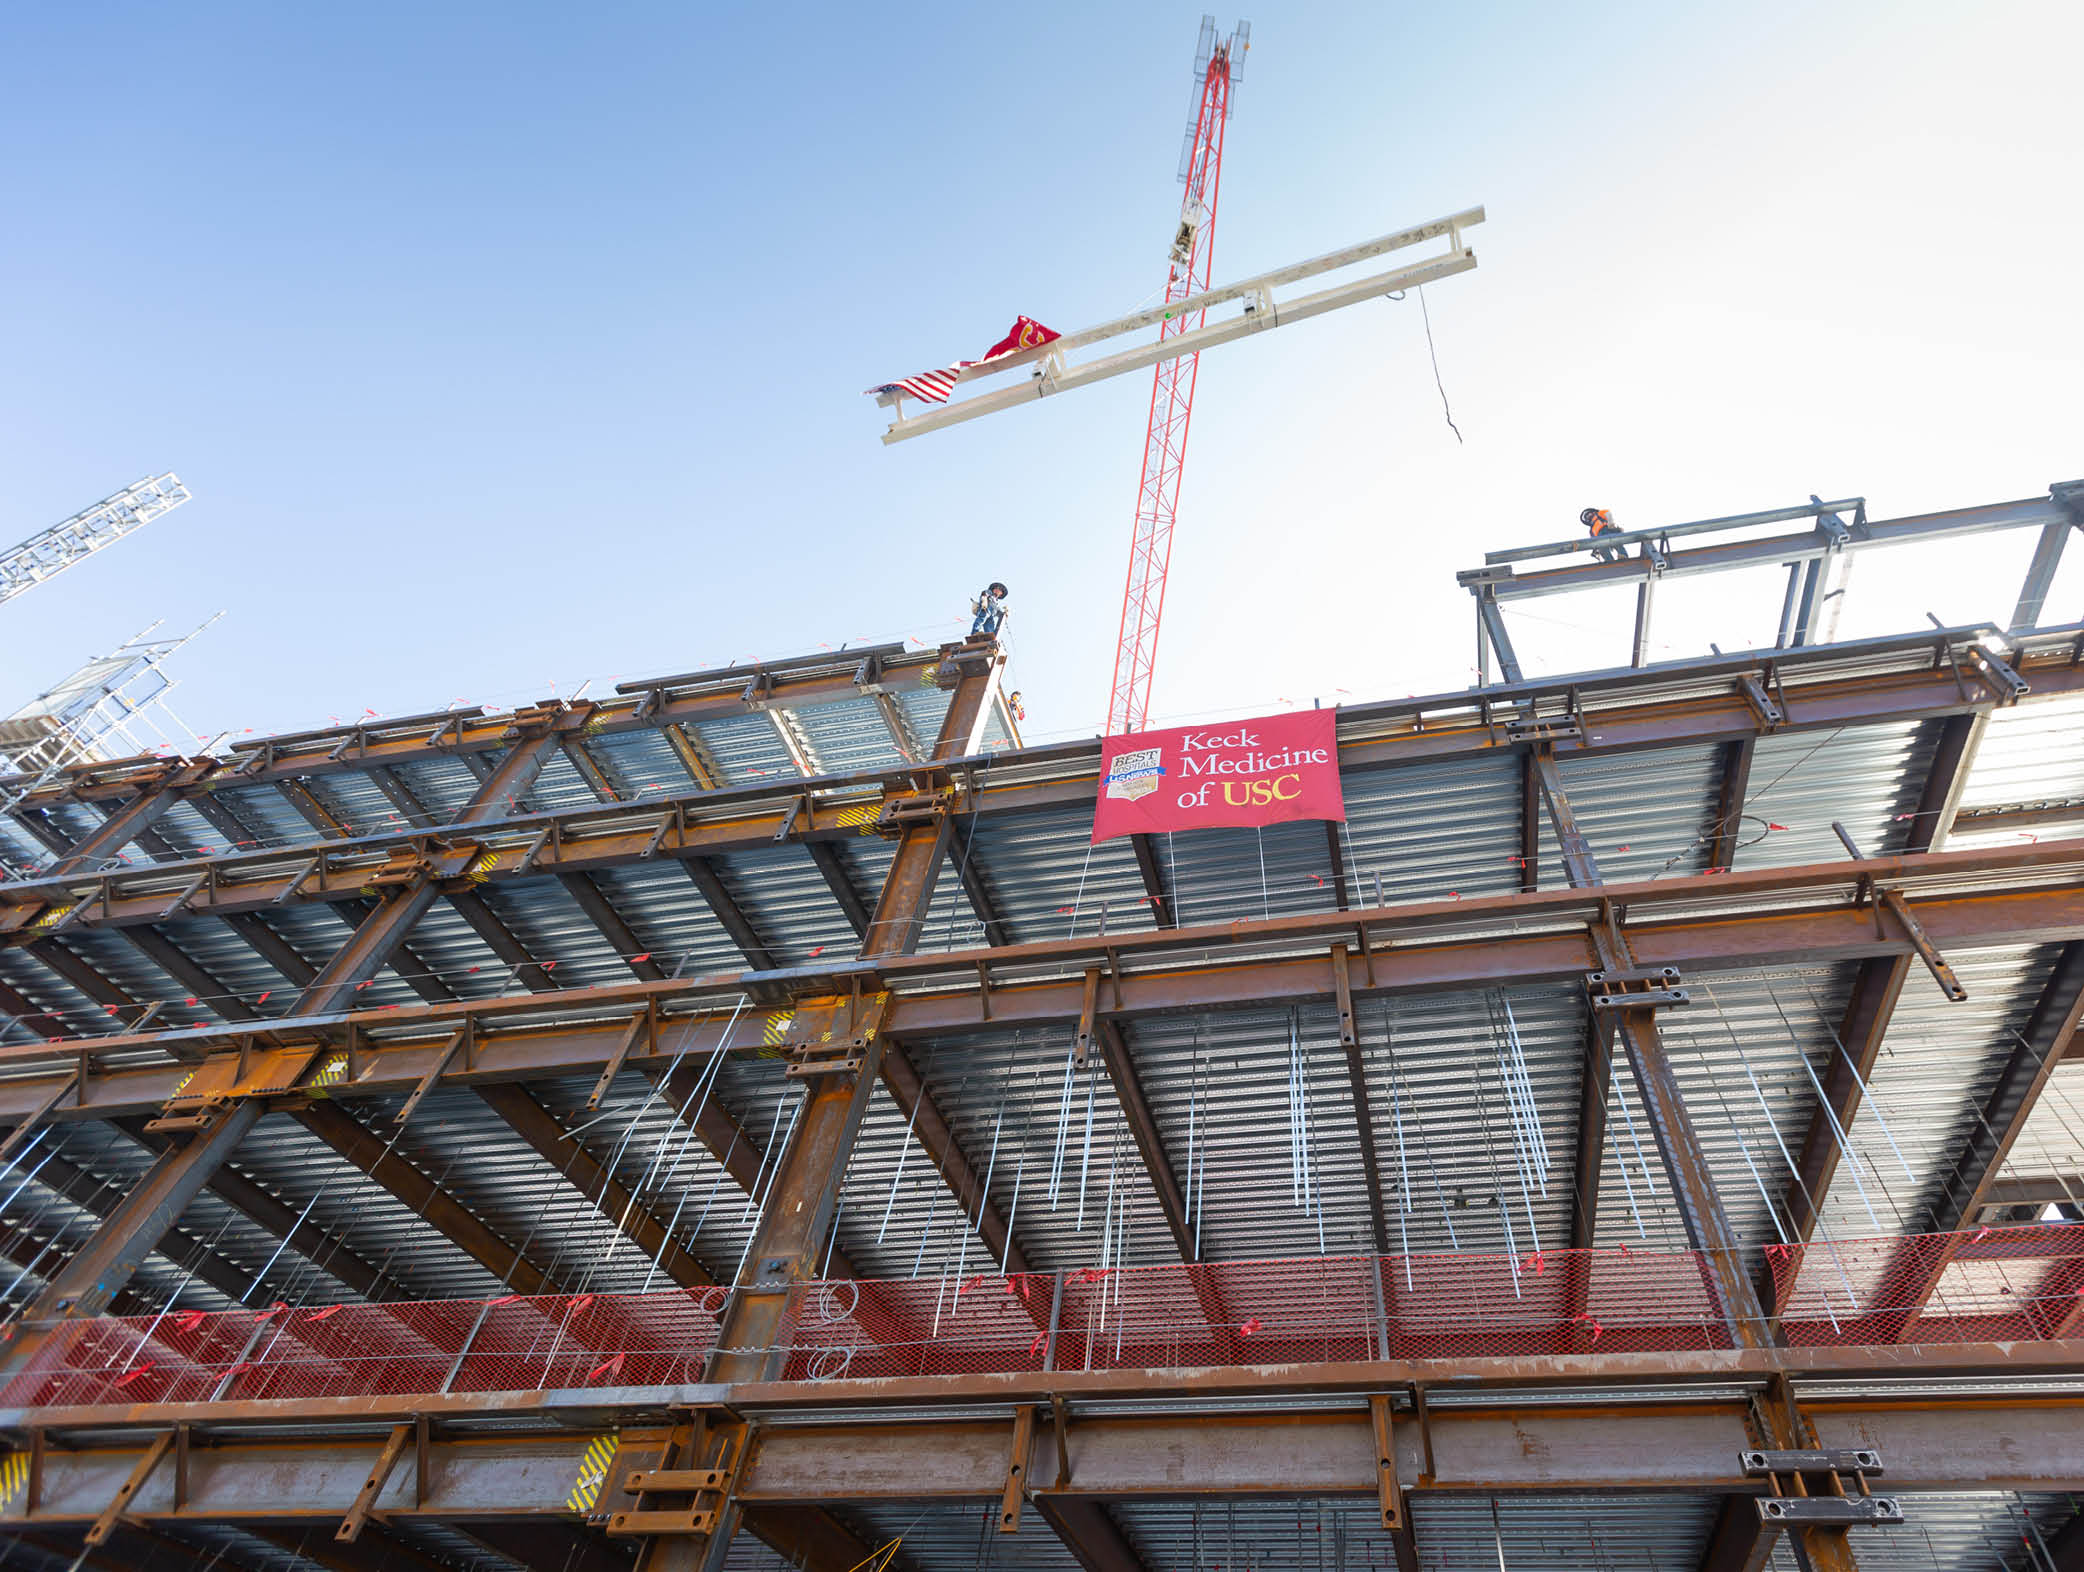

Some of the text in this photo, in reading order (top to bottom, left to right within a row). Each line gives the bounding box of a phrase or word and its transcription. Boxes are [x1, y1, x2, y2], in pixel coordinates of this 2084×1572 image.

[1180, 728, 1262, 753] Keck
[1112, 760, 1157, 775] HOSPITALS
[1113, 751, 1158, 767] BEST
[1178, 746, 1329, 778] Medicine
[1177, 773, 1302, 809] of USC
